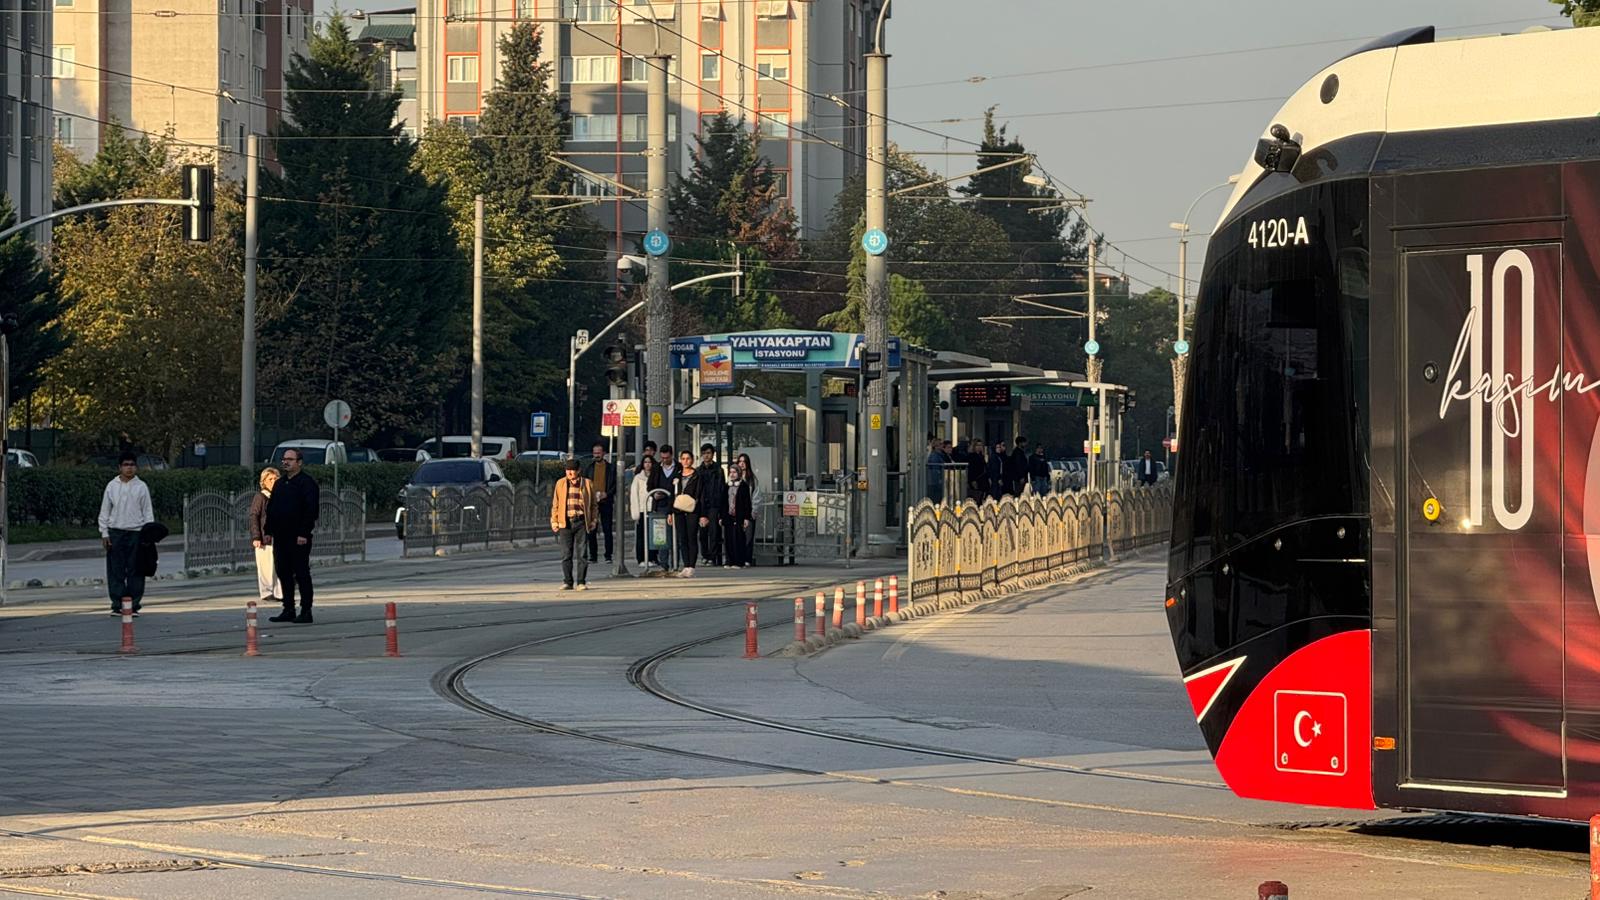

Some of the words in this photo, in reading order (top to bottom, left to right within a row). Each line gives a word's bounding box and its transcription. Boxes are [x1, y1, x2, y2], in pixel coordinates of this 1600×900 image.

[1248, 216, 1309, 248] 4120-A
[668, 343, 694, 351] OTOGAR
[731, 336, 831, 348] YAHYAKAPTAN
[755, 348, 805, 358] İSTASYONU
[1466, 249, 1535, 530] 10
